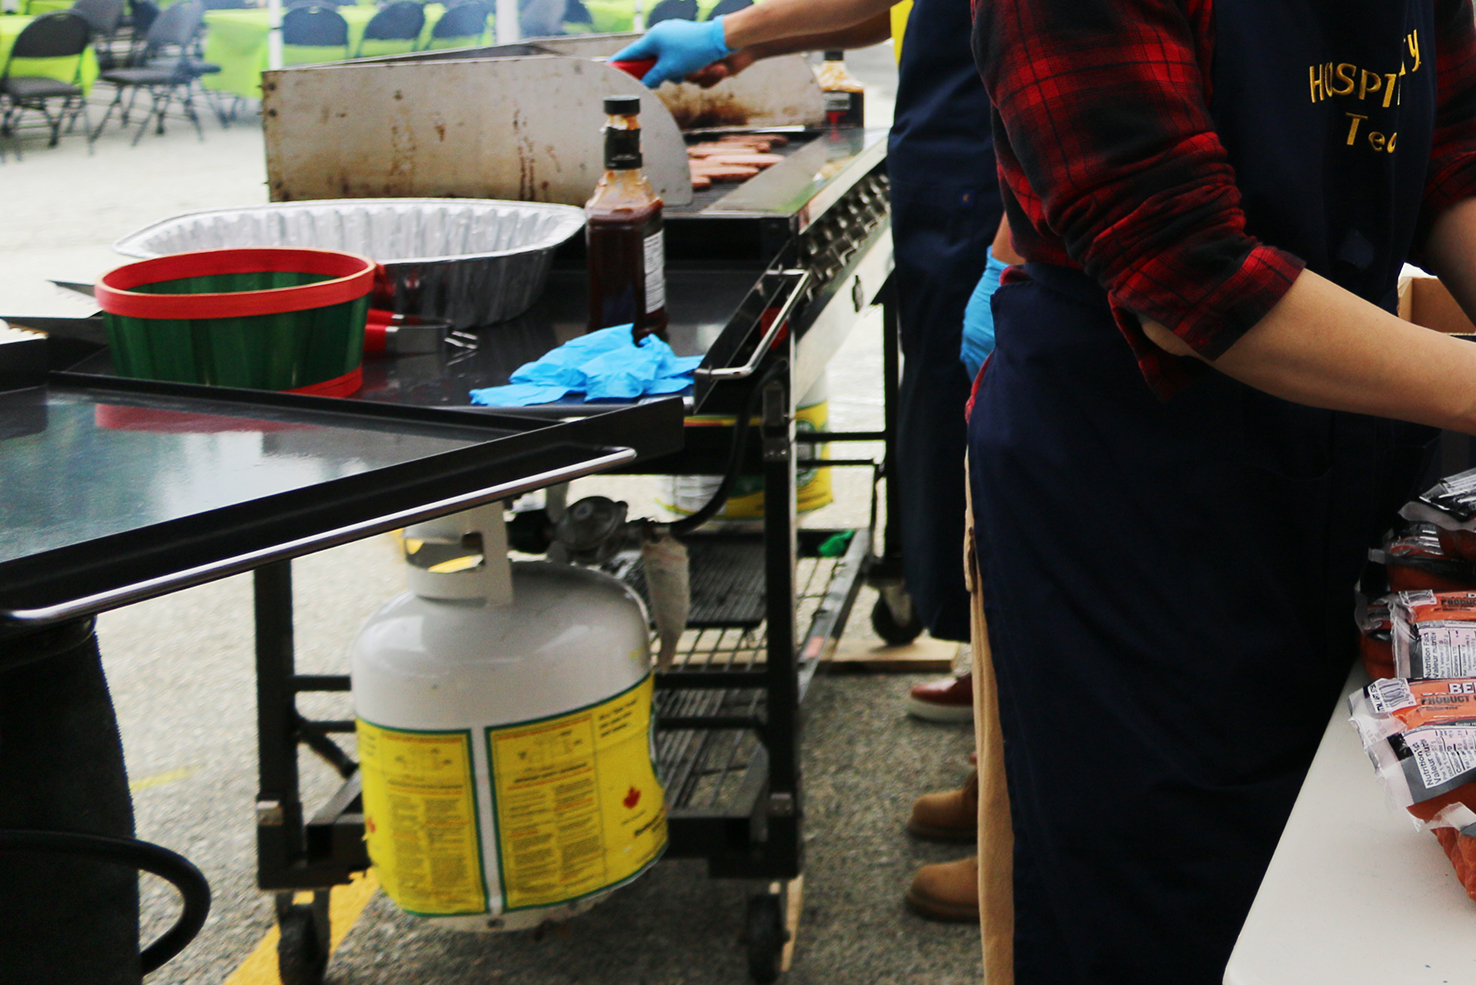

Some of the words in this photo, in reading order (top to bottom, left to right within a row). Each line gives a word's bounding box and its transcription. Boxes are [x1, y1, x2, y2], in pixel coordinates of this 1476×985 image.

[1421, 694, 1470, 705] PRODUCT
[1417, 751, 1434, 786] Nutrition
[1426, 758, 1441, 784] Valeur
